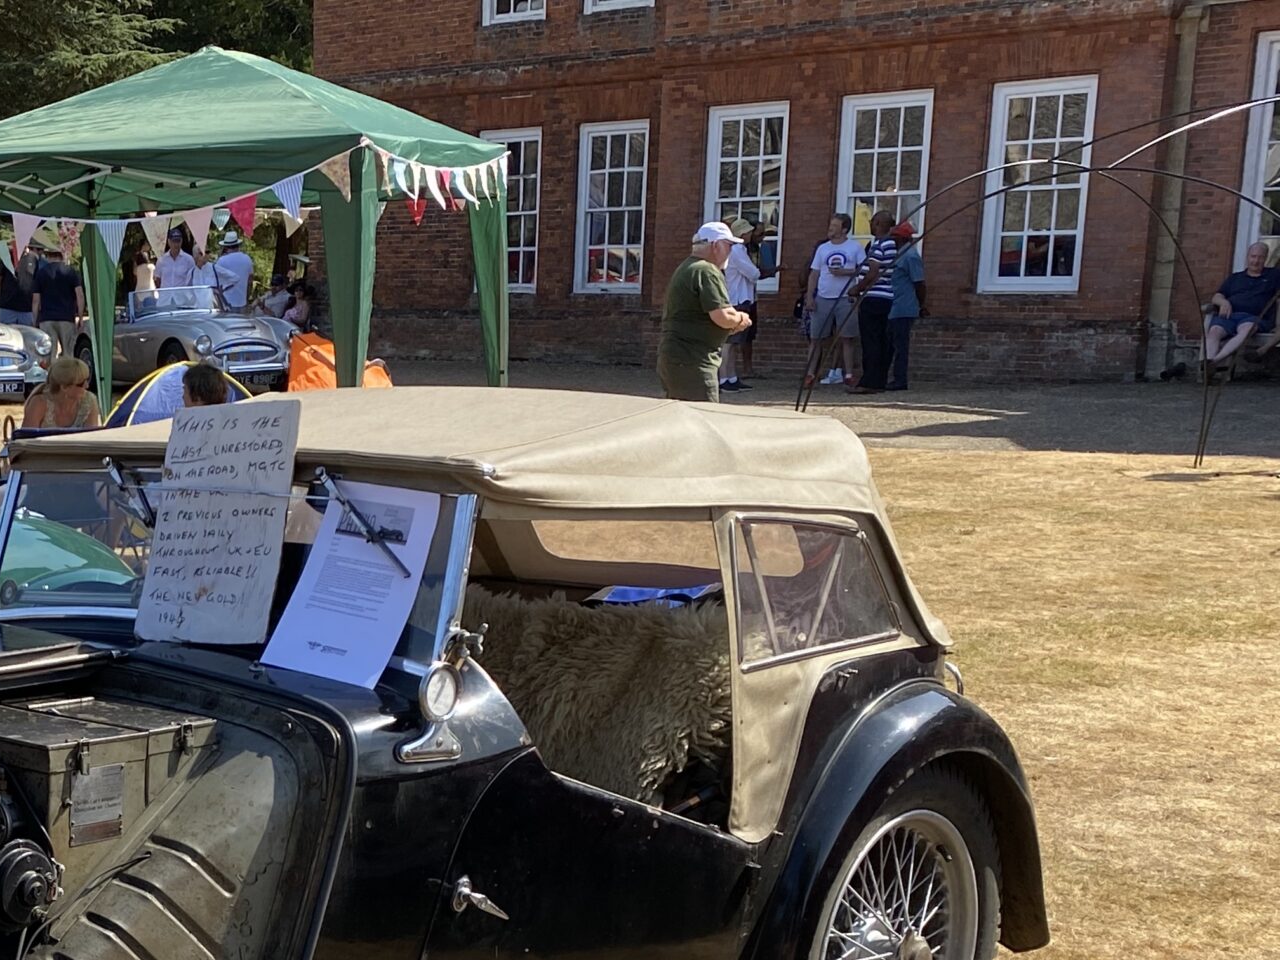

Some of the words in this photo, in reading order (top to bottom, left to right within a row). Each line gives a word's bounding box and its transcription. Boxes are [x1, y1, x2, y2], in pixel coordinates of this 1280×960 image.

[6, 383, 18, 393] KP
[178, 416, 215, 433] THIS
[222, 418, 237, 430] IS
[252, 416, 281, 430] THE
[170, 441, 208, 461] LAST
[167, 471, 181, 481] ON
[185, 466, 203, 478] THE
[161, 511, 170, 522] 2
[231, 508, 277, 519] OWNERS
[159, 531, 197, 542] DRIVEN
[202, 529, 235, 541] DAILY
[227, 546, 242, 556] UK
[253, 543, 273, 556] EU
[148, 589, 171, 602] THE
